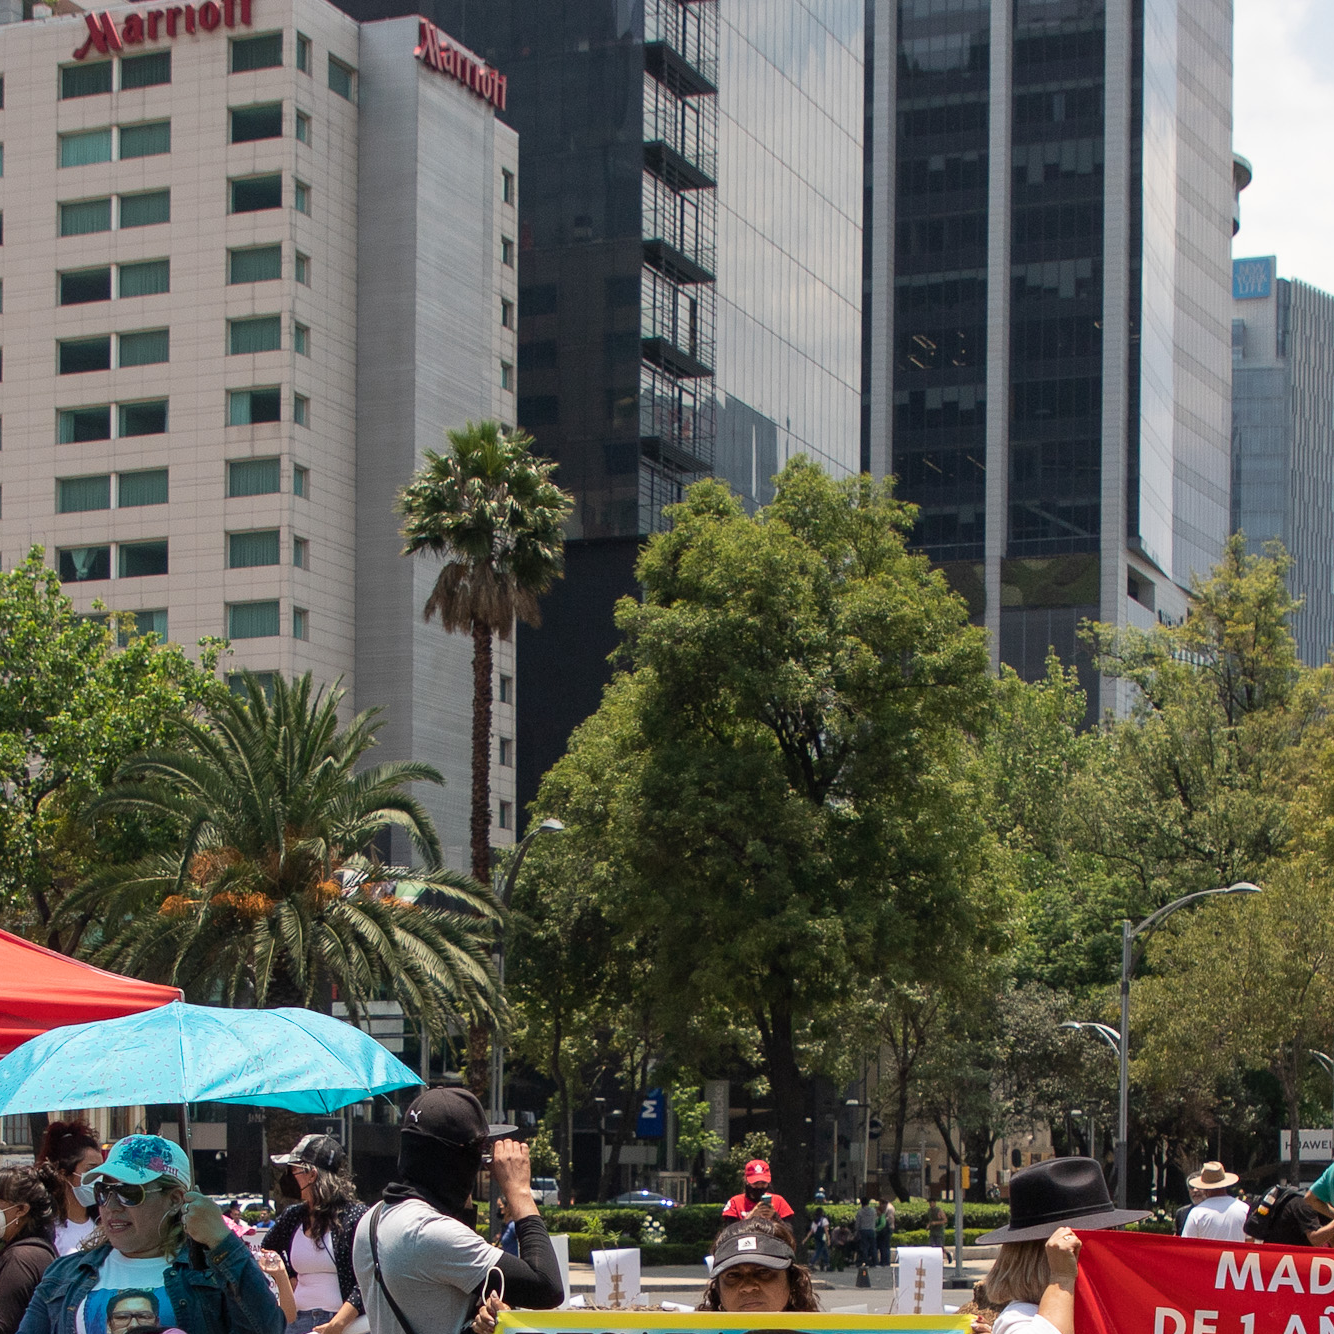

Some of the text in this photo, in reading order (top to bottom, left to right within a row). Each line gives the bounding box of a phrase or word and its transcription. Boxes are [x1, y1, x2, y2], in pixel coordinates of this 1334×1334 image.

[73, 0, 252, 60] Marriott
[413, 18, 507, 112] Marriott
[1285, 1140, 1332, 1150] HAWEI
